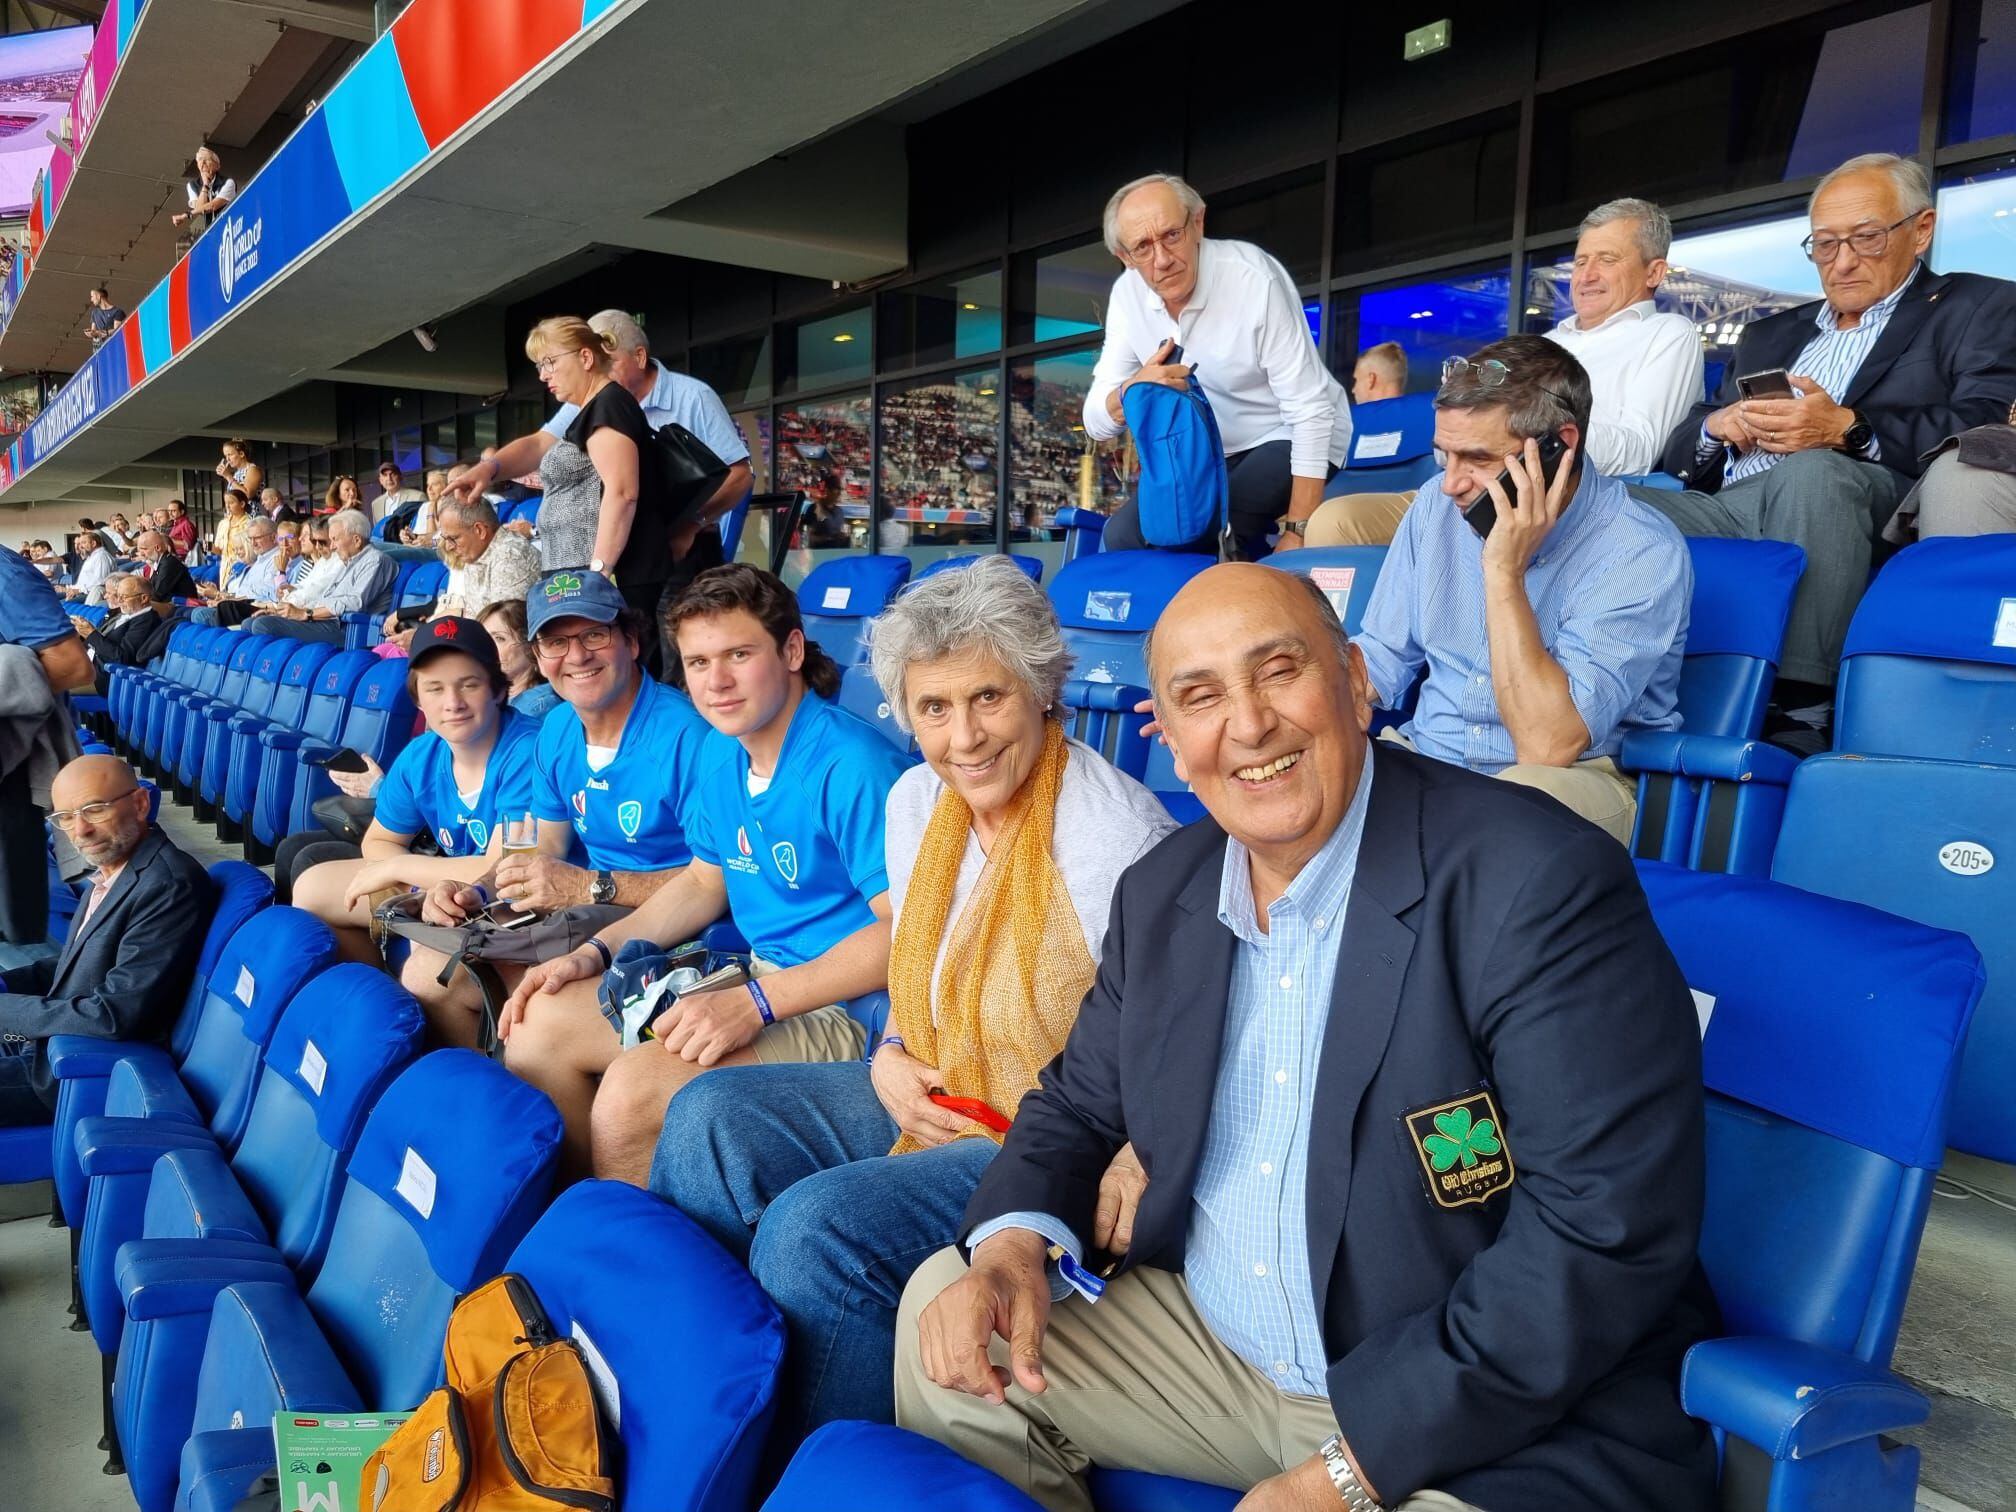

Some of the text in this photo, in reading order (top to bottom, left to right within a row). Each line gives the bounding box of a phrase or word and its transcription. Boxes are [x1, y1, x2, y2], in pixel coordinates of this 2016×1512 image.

[234, 217, 262, 262] WORLD CUP
[726, 857, 750, 869] WORLD
[1950, 848, 1981, 869] 205
[1456, 1175, 1498, 1197] RUGBY
